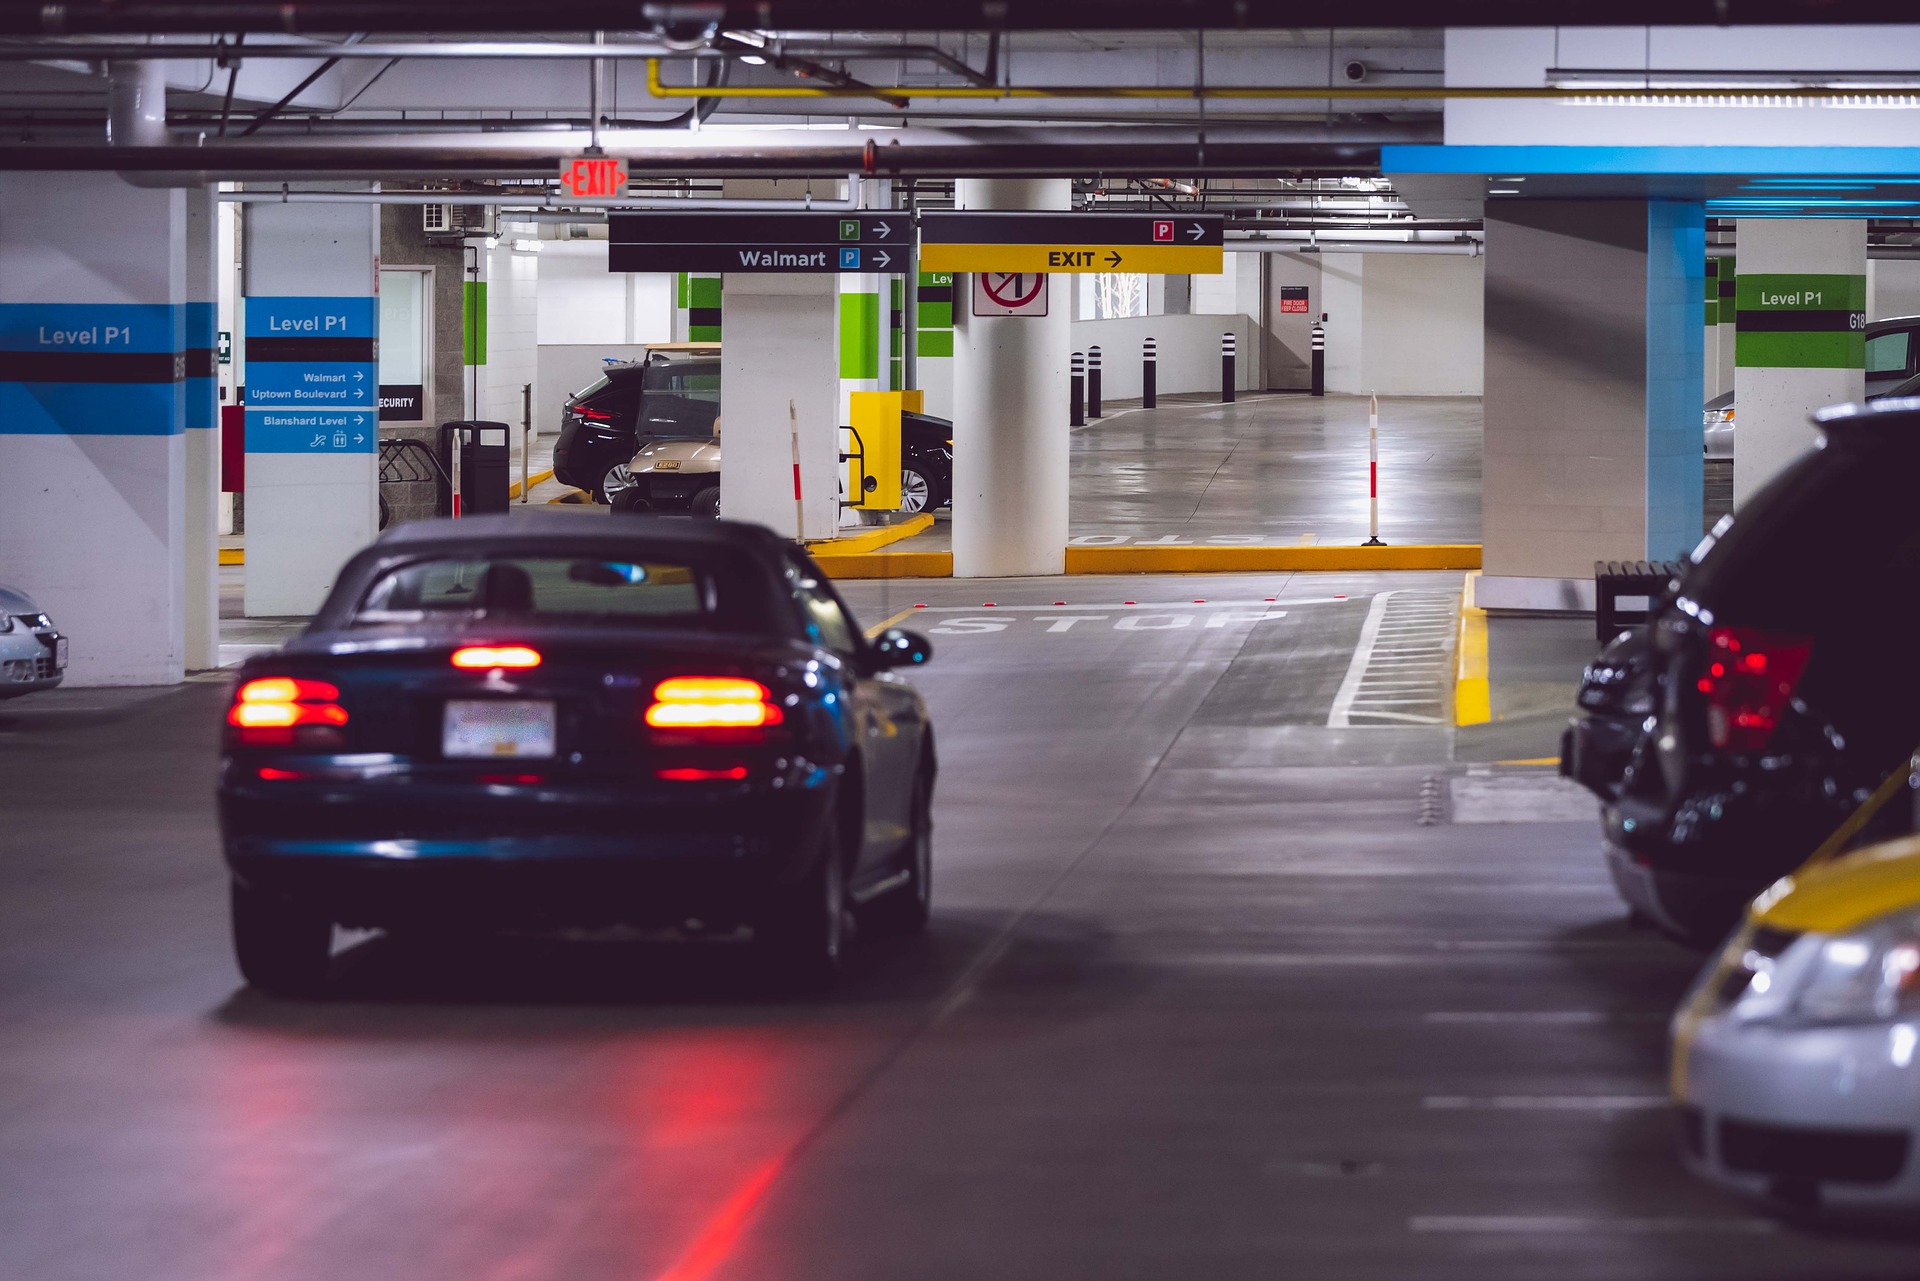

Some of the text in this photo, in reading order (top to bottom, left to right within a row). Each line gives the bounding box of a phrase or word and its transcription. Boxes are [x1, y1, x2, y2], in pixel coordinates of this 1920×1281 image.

[571, 160, 619, 197] EXIT
[845, 223, 855, 236] P
[1159, 224, 1169, 237] P
[739, 250, 855, 267] Walmart P
[1048, 251, 1095, 267] EXIT
[932, 273, 953, 284] Lev
[1761, 291, 1822, 305] Level P1
[269, 315, 347, 331] Level P1
[1849, 313, 1865, 329] G18
[39, 326, 130, 345] Level P1
[303, 373, 346, 382] Walmart
[251, 389, 347, 400] Uptown Boulevard
[379, 397, 414, 408] ECURITY
[263, 416, 347, 426] Blanshard Level
[1068, 534, 1268, 546] STO
[928, 611, 1287, 635] STOP
